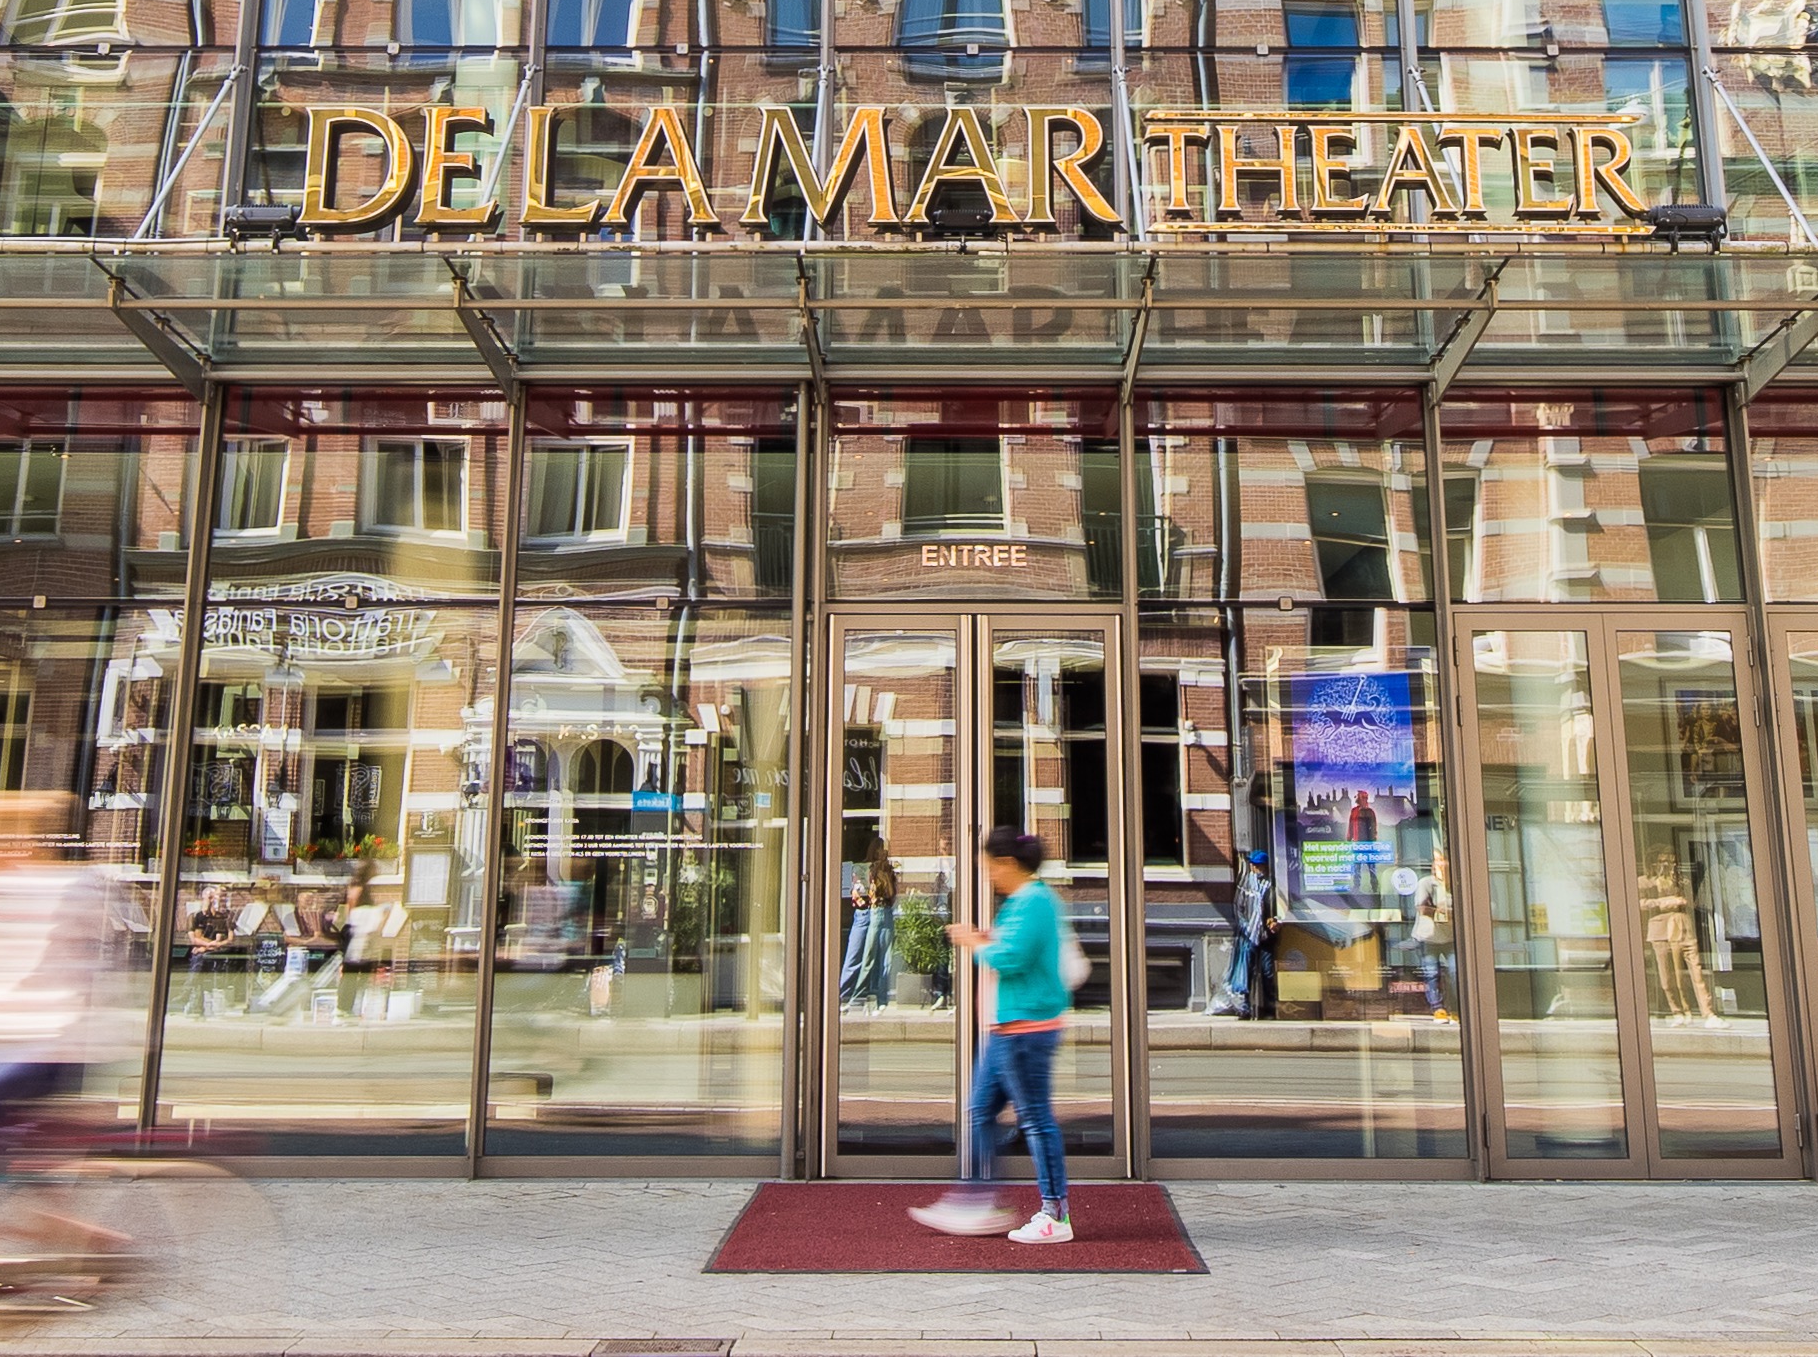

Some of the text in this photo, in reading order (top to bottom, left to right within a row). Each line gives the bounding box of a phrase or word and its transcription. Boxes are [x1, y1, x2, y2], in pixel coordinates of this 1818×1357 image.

[296, 106, 1650, 231] DE LA MAR THEATER
[922, 545, 1027, 567] ENTREE
